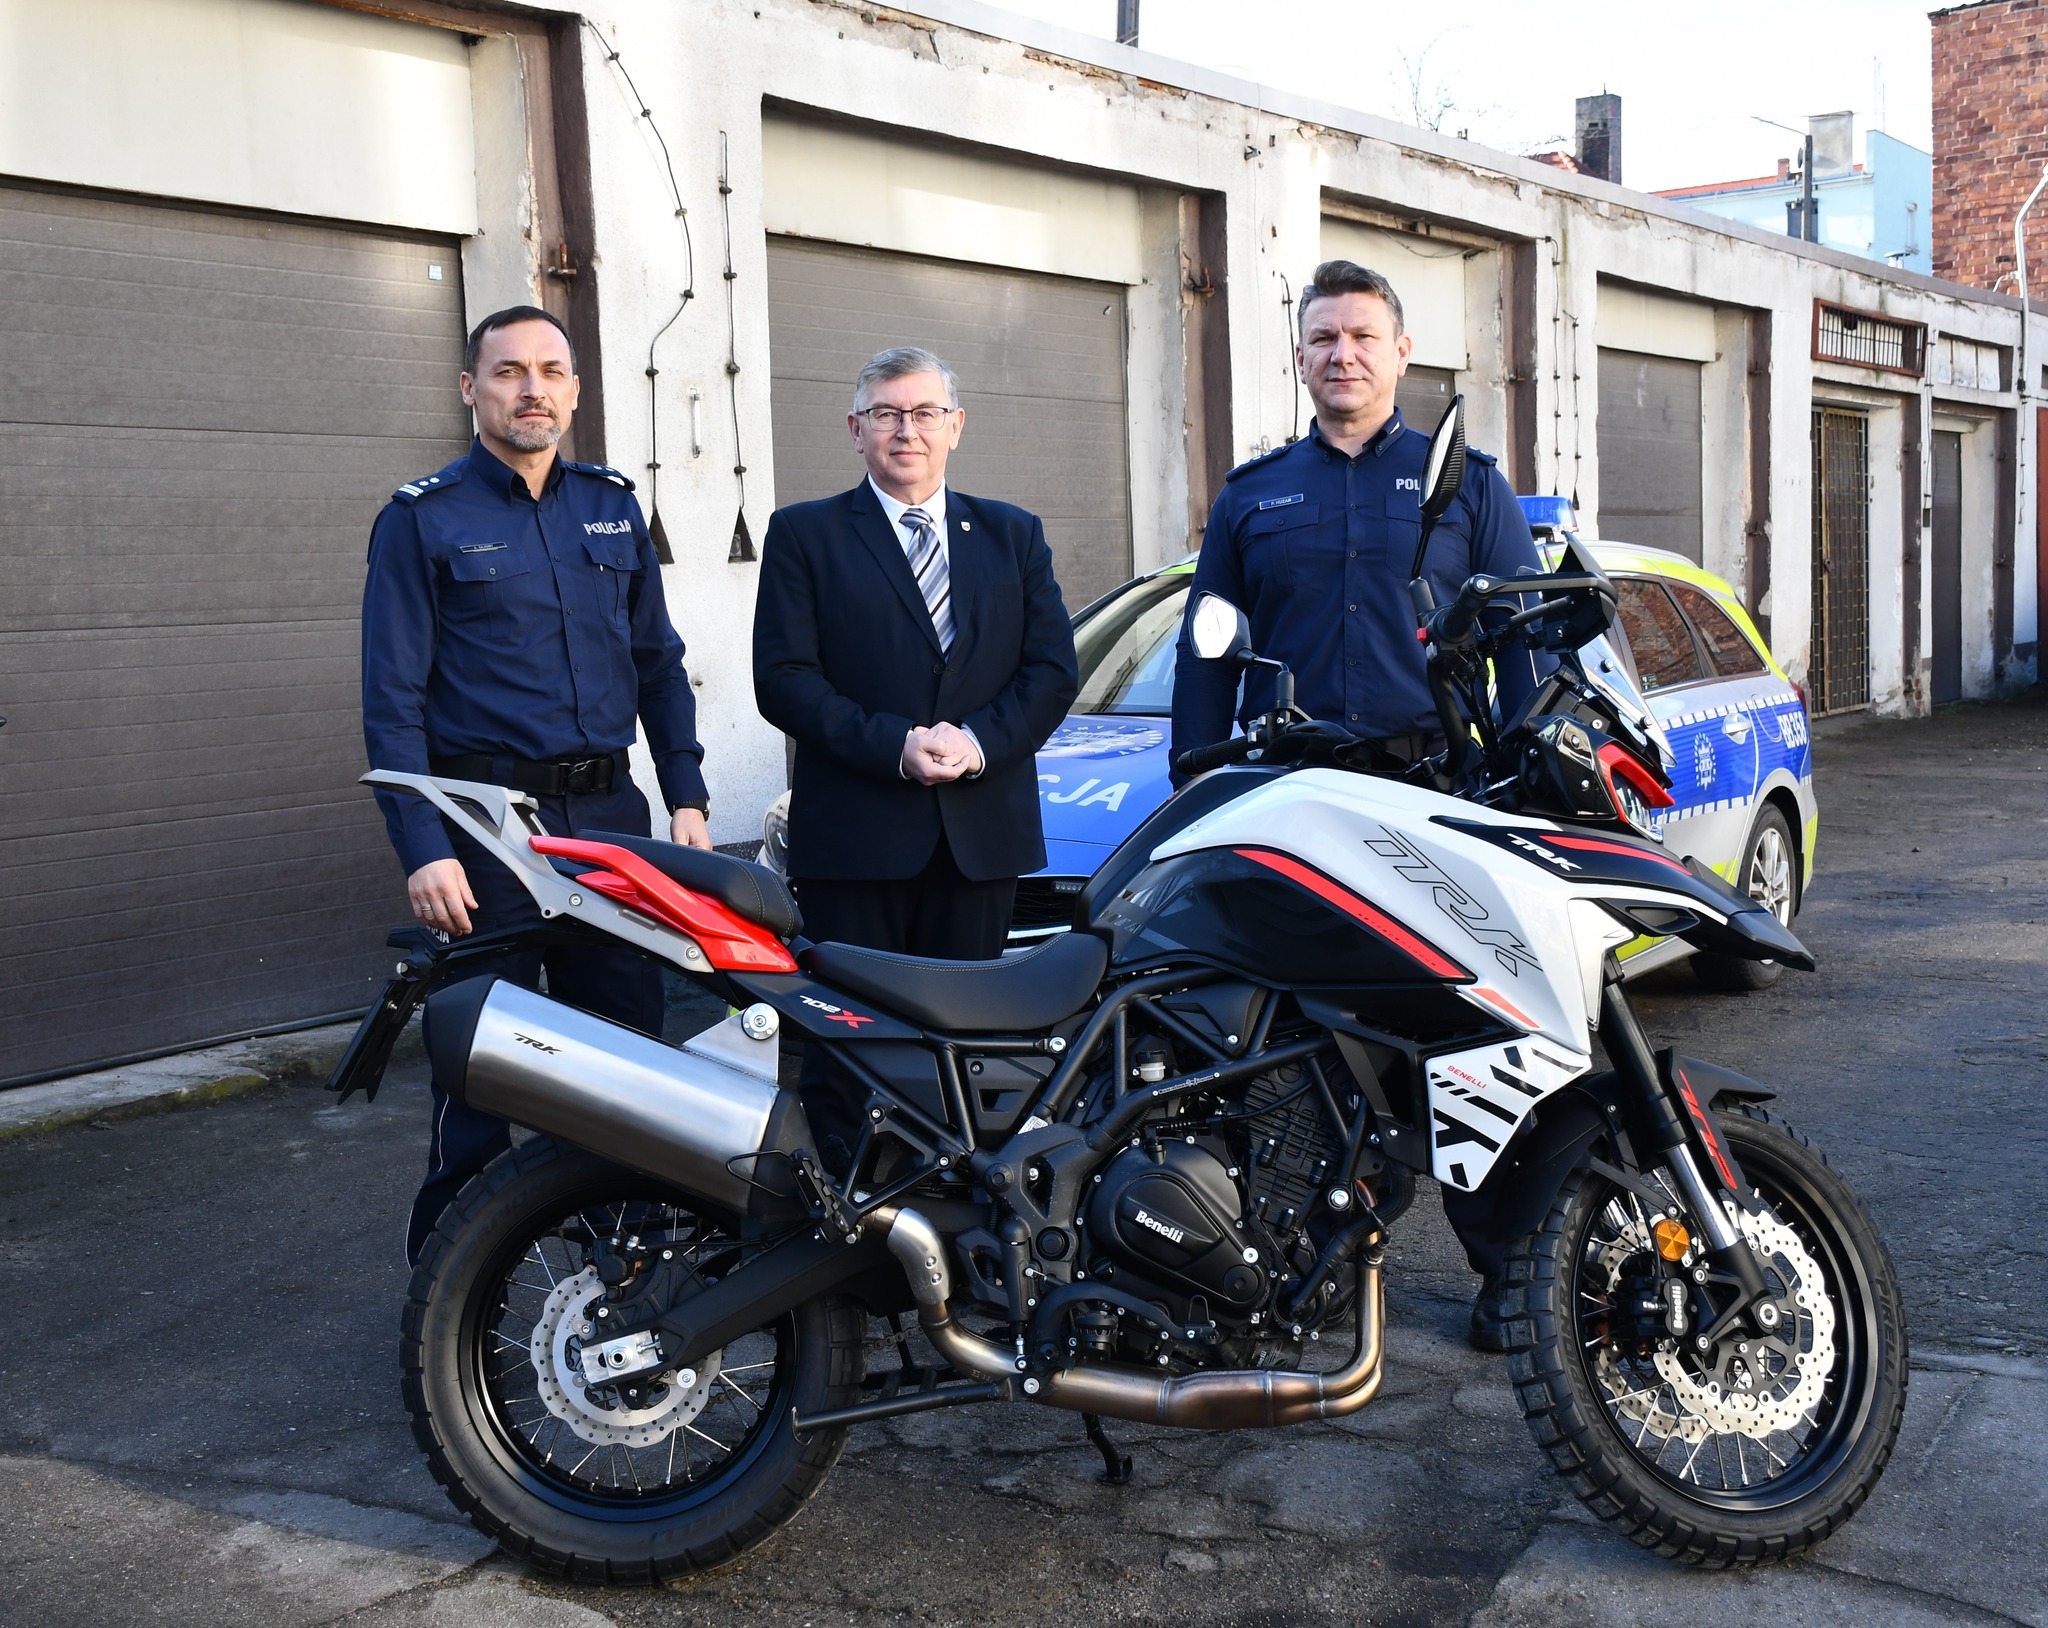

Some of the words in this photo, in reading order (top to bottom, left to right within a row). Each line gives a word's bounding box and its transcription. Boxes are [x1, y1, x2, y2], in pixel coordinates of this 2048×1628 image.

[583, 519, 632, 535] POLICJA
[1507, 833, 1582, 871] TRK
[1364, 824, 1543, 977] TRK
[513, 1032, 563, 1056] TRK
[1447, 1065, 1487, 1089] BENELLI
[1135, 1209, 1184, 1244] Benelli
[1673, 1285, 1684, 1329] Benelli
[1875, 1278, 1897, 1388] PIRELLI
